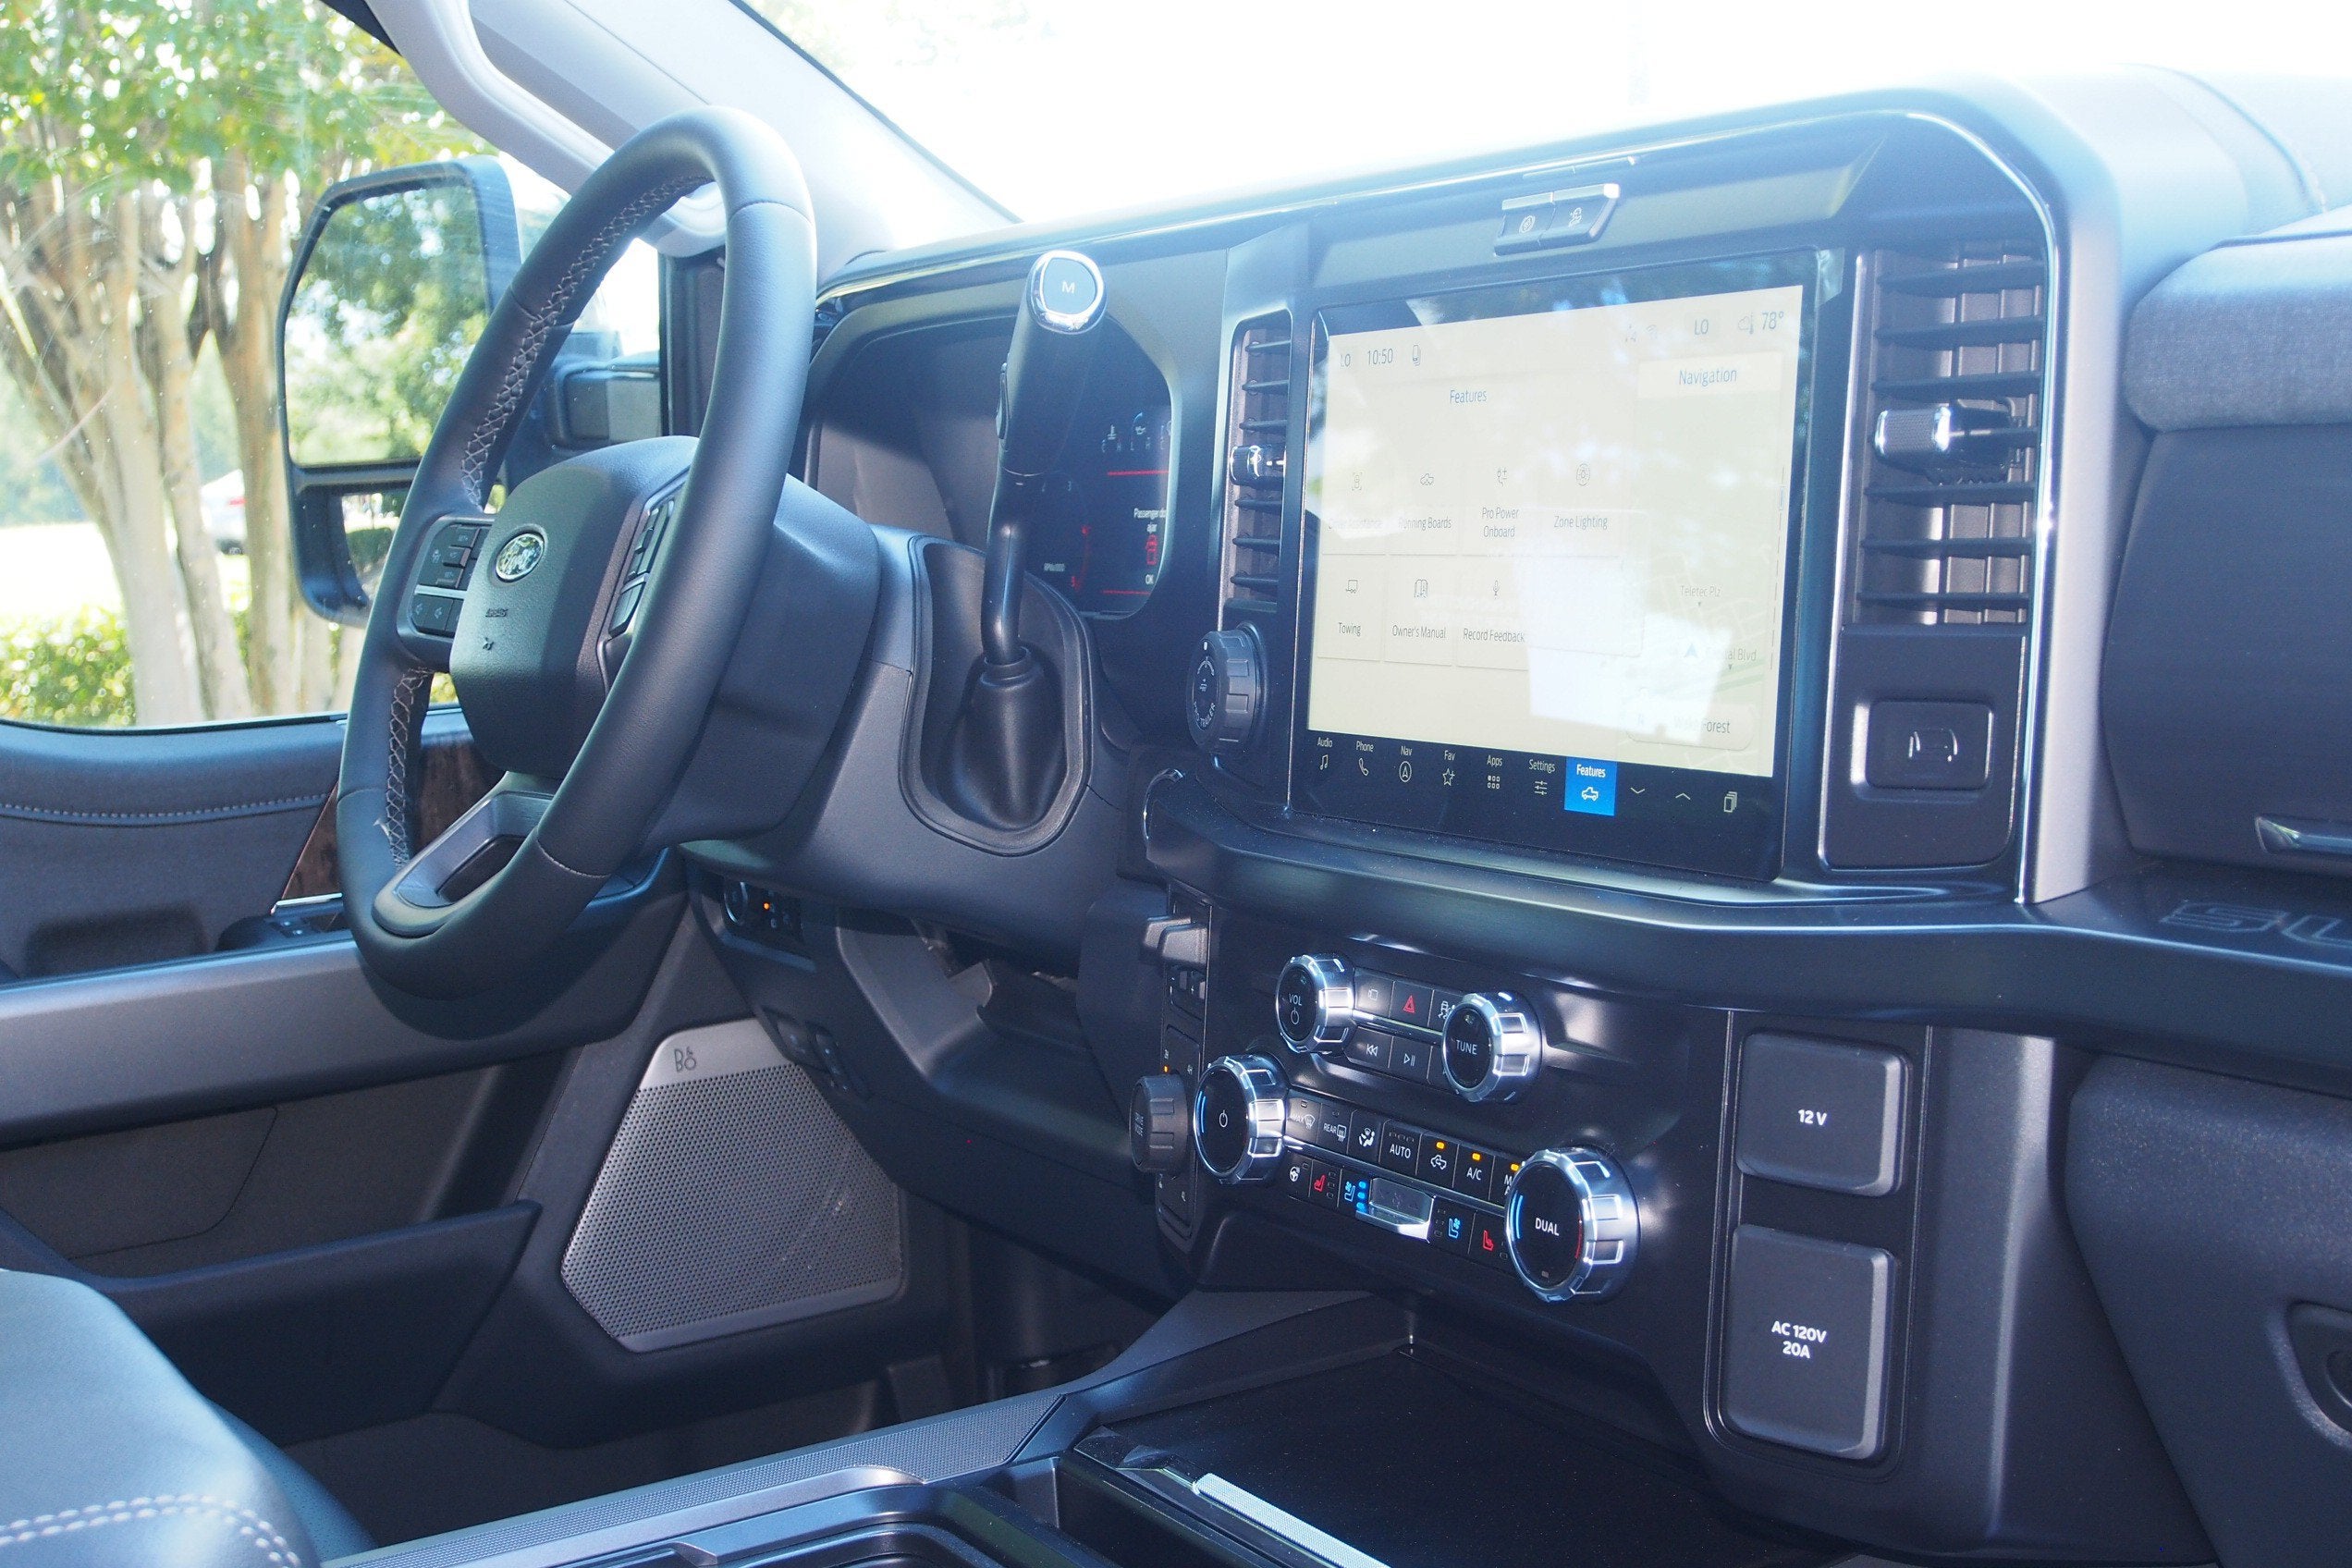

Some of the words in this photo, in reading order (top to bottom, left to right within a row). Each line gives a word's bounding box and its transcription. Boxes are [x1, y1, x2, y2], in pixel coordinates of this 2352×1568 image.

[1060, 280, 1076, 294] M
[1694, 318, 1709, 336] LO
[1367, 348, 1394, 365] 10:50
[1679, 367, 1738, 386] Navigation
[1449, 389, 1488, 404] Features
[1481, 507, 1494, 520] Pro
[1496, 507, 1519, 520] Power
[1427, 515, 1452, 529] Boards
[1553, 515, 1574, 529] Zone
[1575, 515, 1608, 531] Lighting
[1483, 525, 1515, 538] Onboard
[1338, 622, 1361, 637] Towing
[1391, 624, 1419, 638] Owner's
[1420, 625, 1447, 639] Manual
[1463, 628, 1488, 642] Record
[1489, 629, 1525, 643] Feedback
[1737, 647, 1758, 662] Blvd
[1317, 737, 1333, 748] Audio
[1355, 741, 1374, 753] Phone
[1401, 745, 1413, 756] Nav
[1444, 750, 1457, 761] Fav
[1486, 754, 1503, 768] Apps
[1528, 759, 1556, 774] Settings
[1576, 764, 1607, 778] Features
[1288, 993, 1303, 1007] VOL
[1455, 1039, 1477, 1055] TUNE
[1323, 1122, 1337, 1133] REAR
[1389, 1144, 1412, 1159] AUTO
[1466, 1167, 1483, 1181] A/C
[1535, 1217, 1560, 1236] DUAL
[1771, 1320, 1791, 1336] AC
[1793, 1325, 1827, 1343] 120V
[1782, 1341, 1810, 1359] 20A
